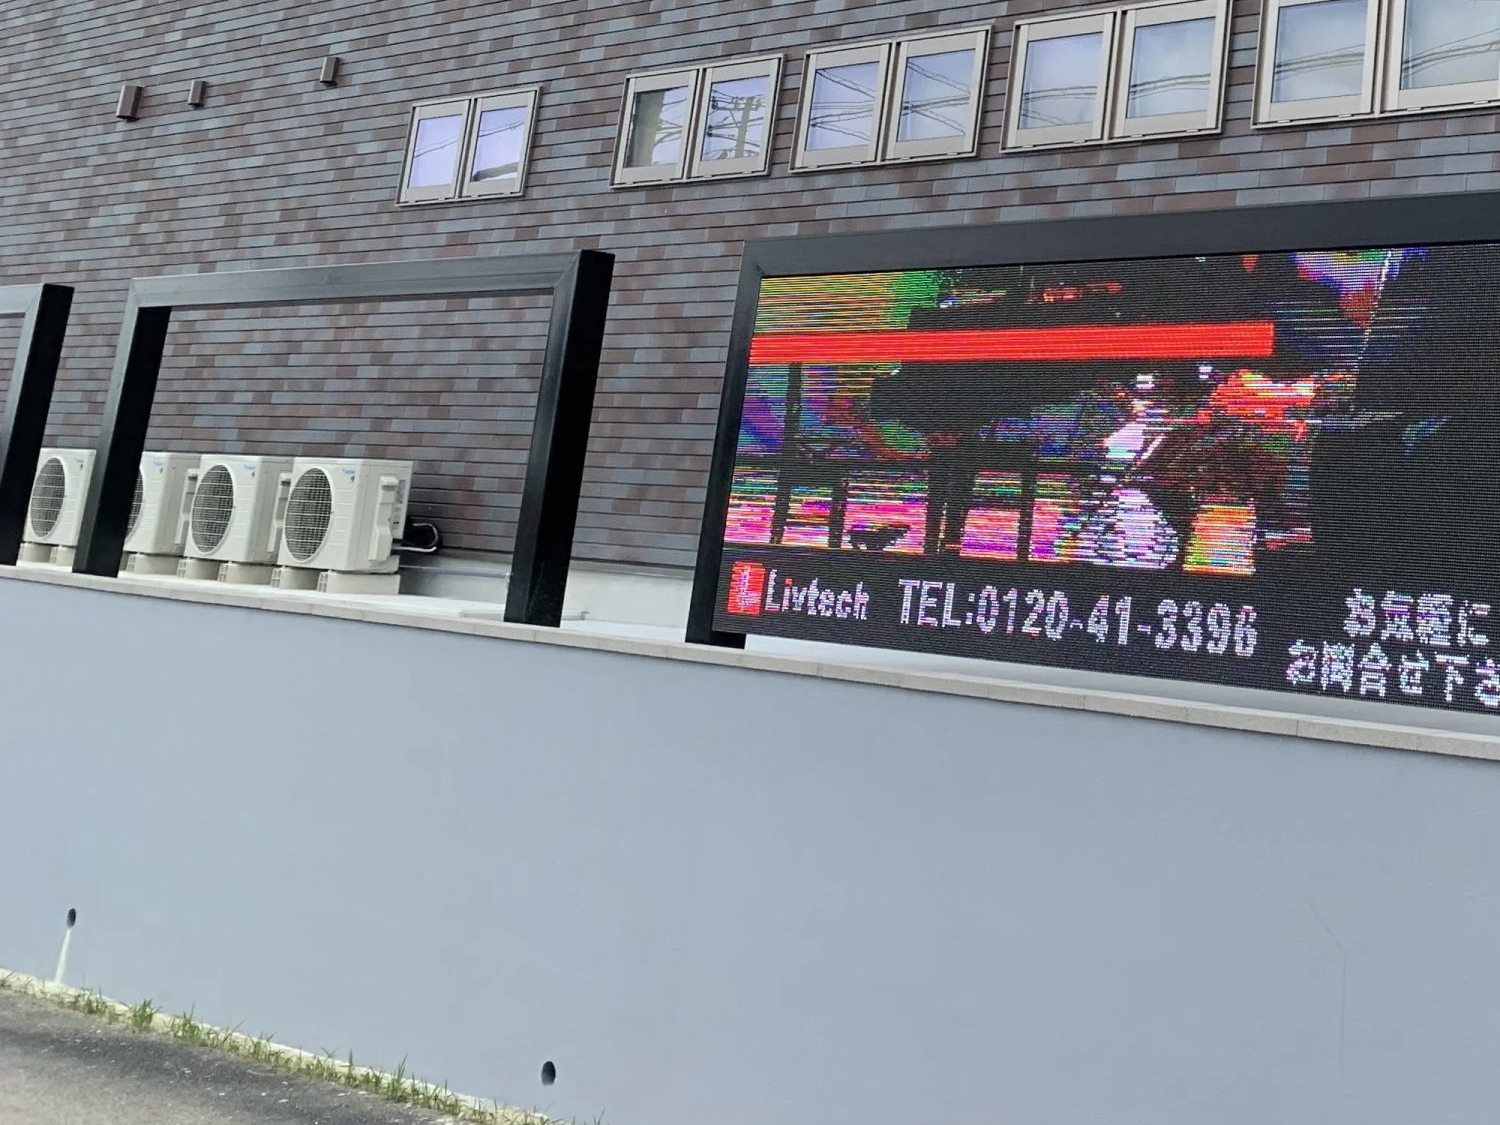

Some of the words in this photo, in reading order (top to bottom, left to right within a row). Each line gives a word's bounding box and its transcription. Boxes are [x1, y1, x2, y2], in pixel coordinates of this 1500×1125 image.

[765, 569, 870, 620] Livtech
[1343, 588, 1491, 647] お気軽に
